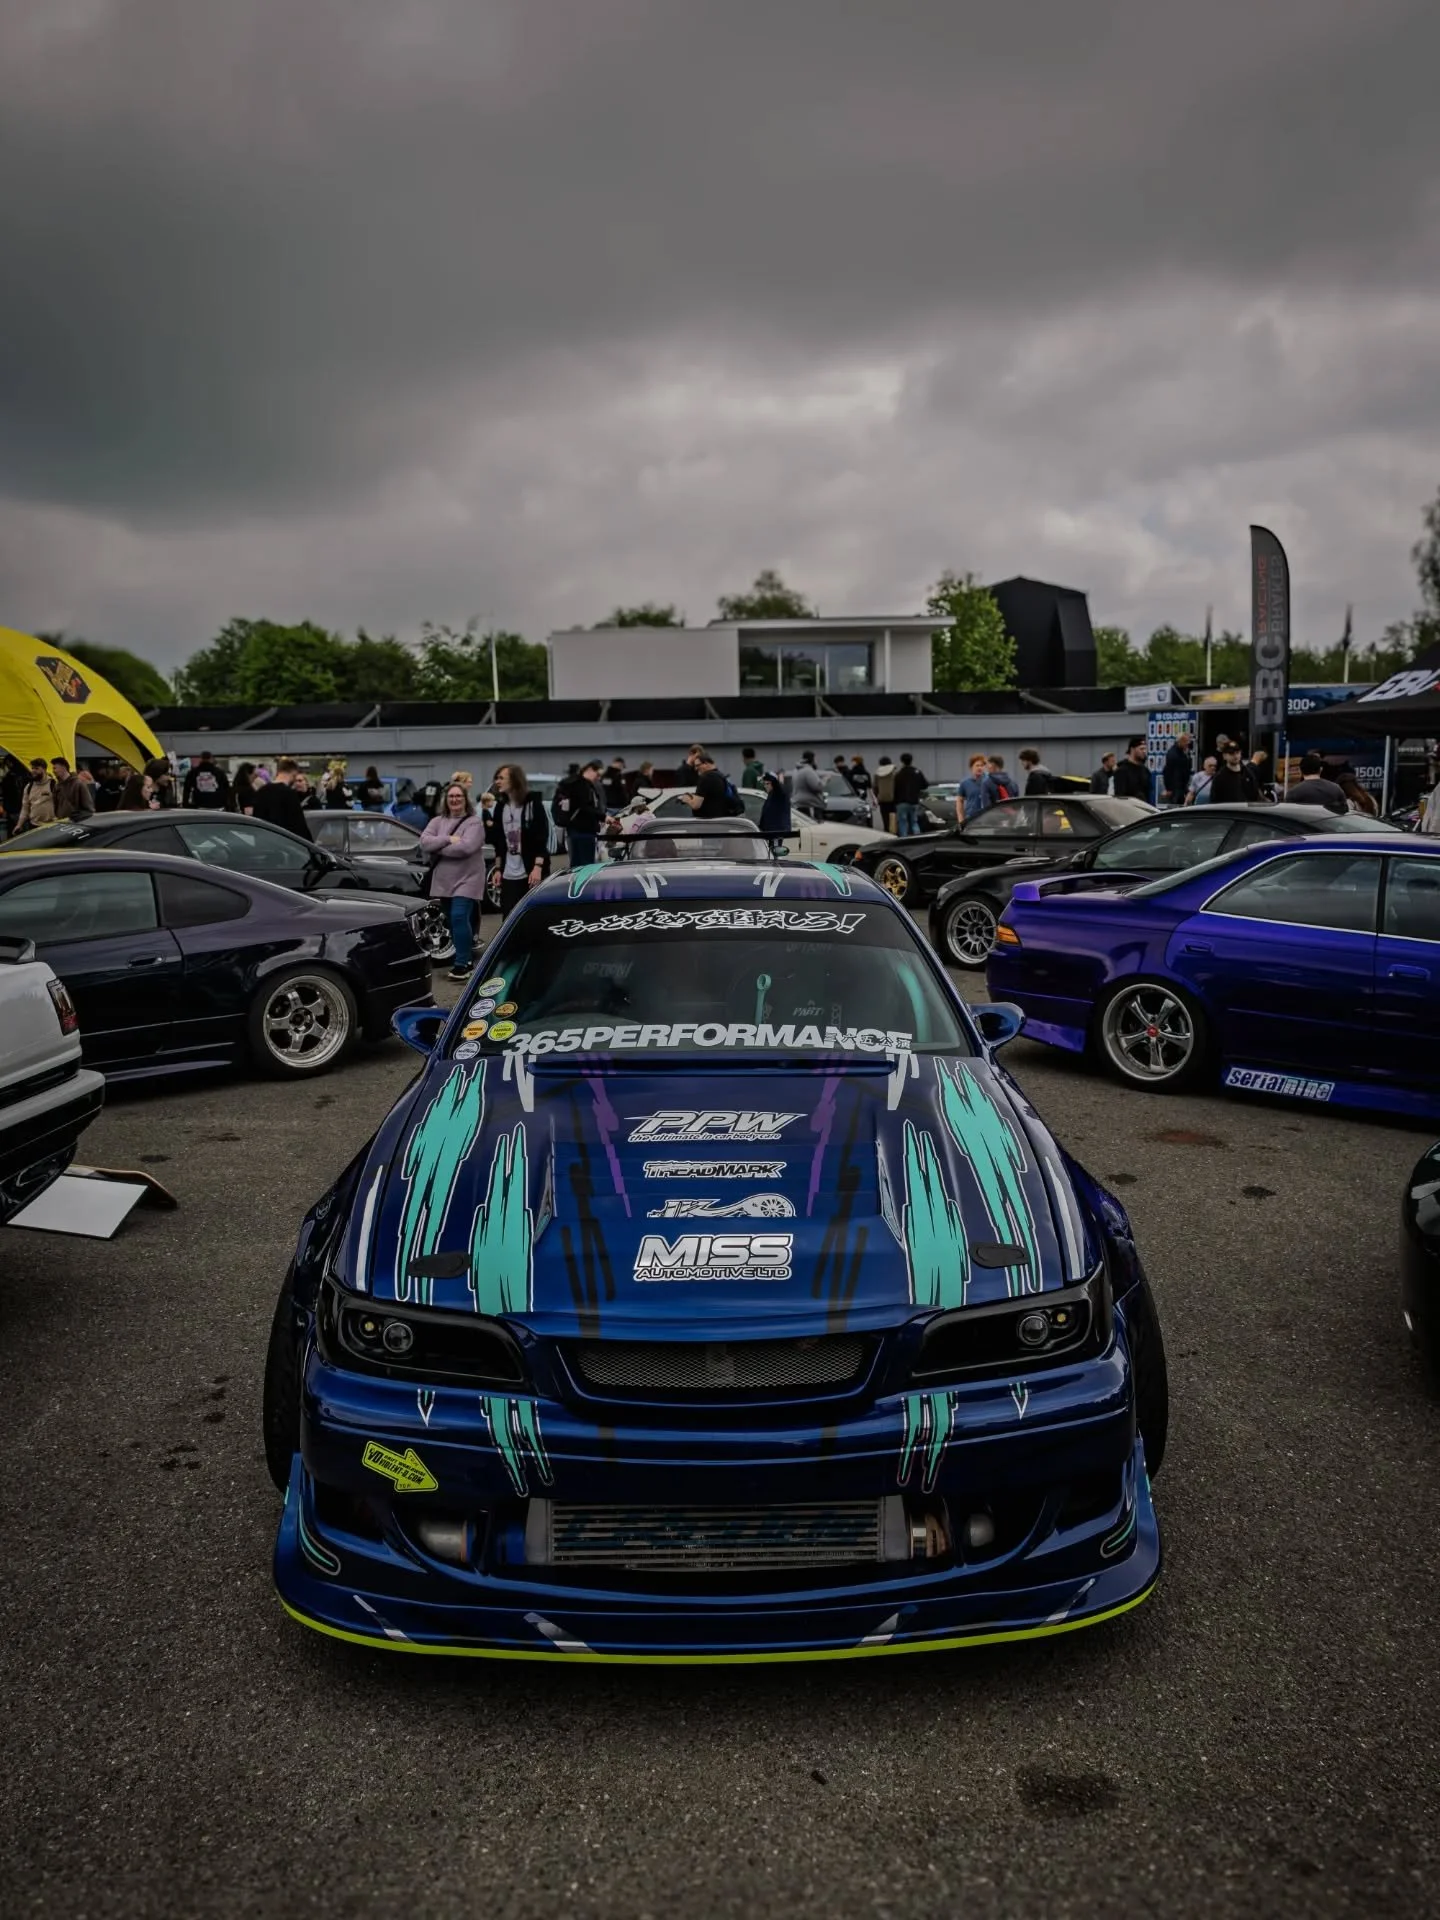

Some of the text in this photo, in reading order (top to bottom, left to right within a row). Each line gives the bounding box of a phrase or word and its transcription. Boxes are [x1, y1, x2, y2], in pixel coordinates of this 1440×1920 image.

[503, 1023, 913, 1056] 365PERFORMANCE
[630, 1133, 650, 1141] the
[651, 1133, 700, 1141] ultimate
[701, 1132, 712, 1140] in
[732, 1132, 758, 1141] body
[759, 1132, 782, 1140] care
[631, 1111, 804, 1134] PPW
[636, 1235, 792, 1268] MISS
